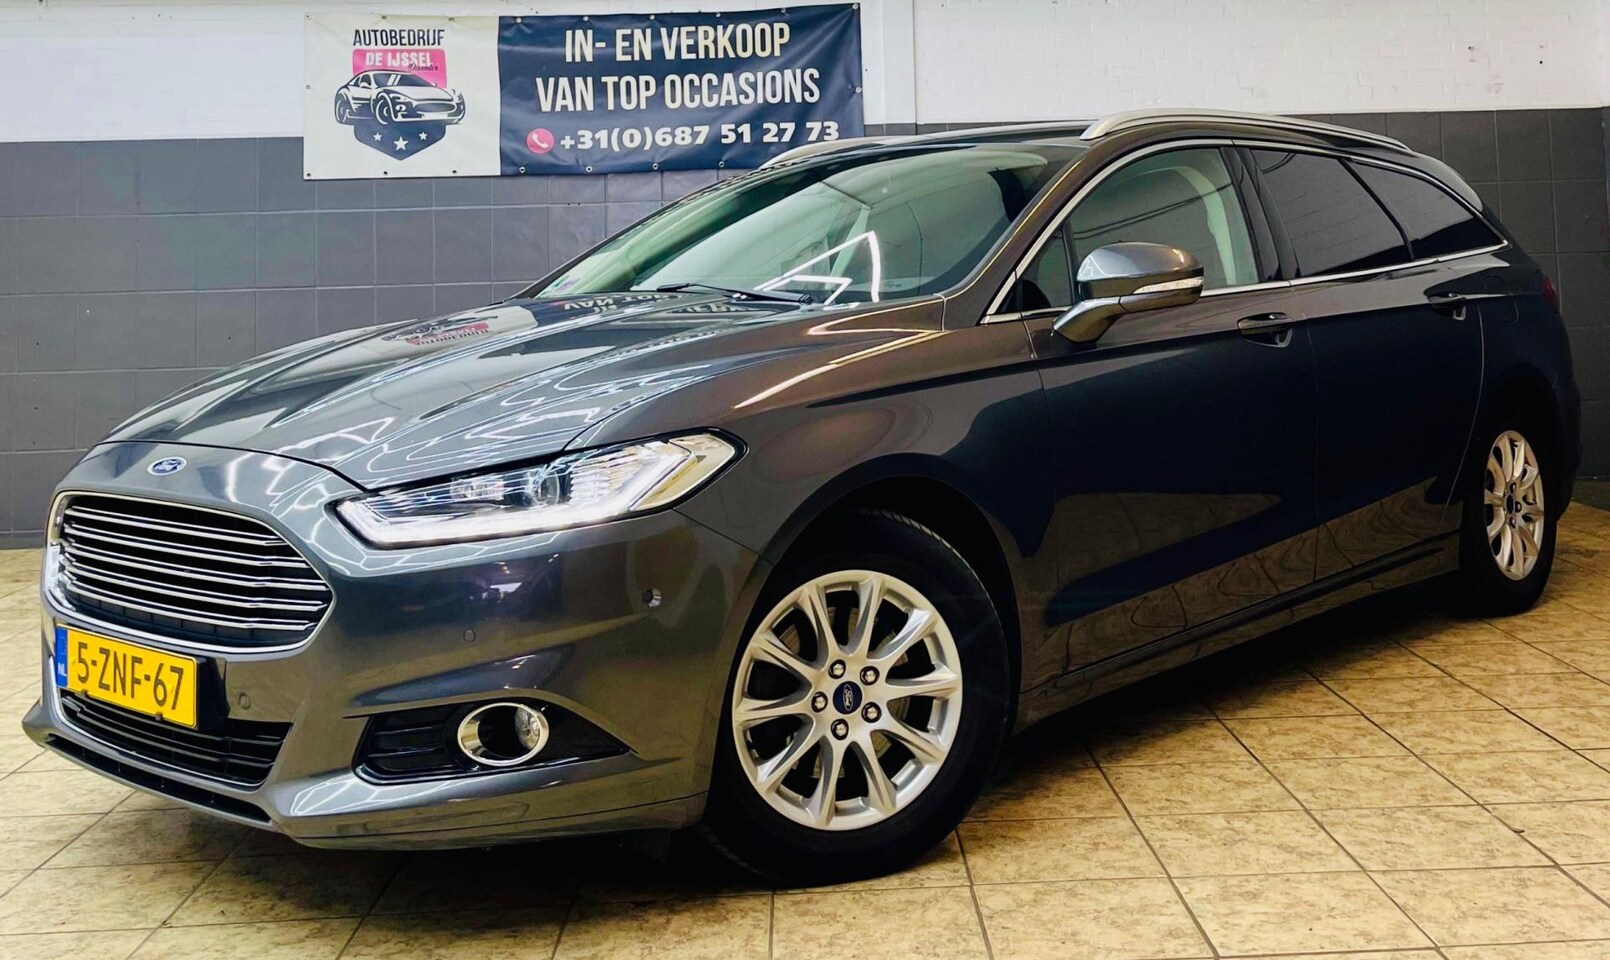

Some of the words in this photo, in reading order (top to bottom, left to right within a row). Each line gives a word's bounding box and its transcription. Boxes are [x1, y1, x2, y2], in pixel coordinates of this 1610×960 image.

[353, 29, 445, 46] AUTOBEDRIJF
[565, 29, 606, 63] IN-
[615, 28, 652, 61] EN
[660, 22, 790, 60] VERKOOP
[365, 52, 383, 66] DE
[387, 52, 432, 67] IJSSEL
[535, 76, 595, 112] VAN
[601, 75, 656, 111] TOP
[664, 67, 820, 110] OCCASIONS
[560, 125, 710, 151] +31(0)687
[720, 123, 750, 144] 51
[762, 122, 796, 143] 27
[805, 121, 839, 141] 73
[57, 662, 68, 676] NL
[77, 641, 184, 710] 5-ZNF-67
